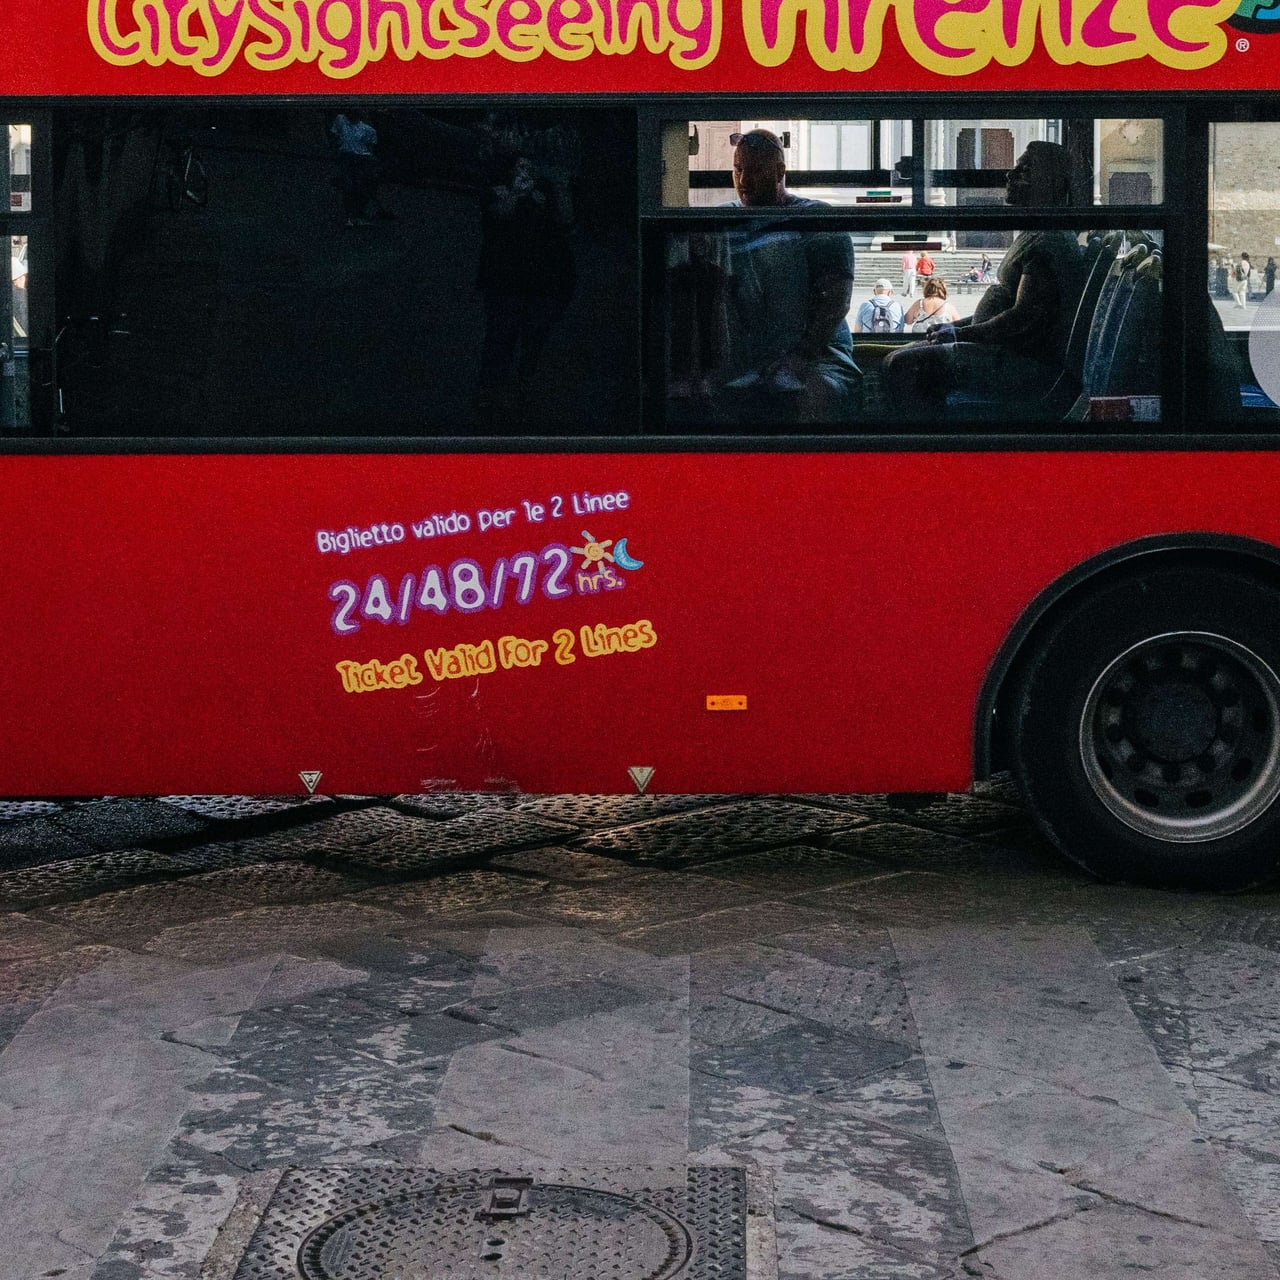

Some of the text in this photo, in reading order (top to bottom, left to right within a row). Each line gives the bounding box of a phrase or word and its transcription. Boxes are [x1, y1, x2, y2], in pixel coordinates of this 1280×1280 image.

[316, 490, 630, 554] Biglietto valido per le 2 Linee
[329, 545, 572, 634] 24/48/72
[336, 619, 658, 693] Ticket Valid For 2 Lines
